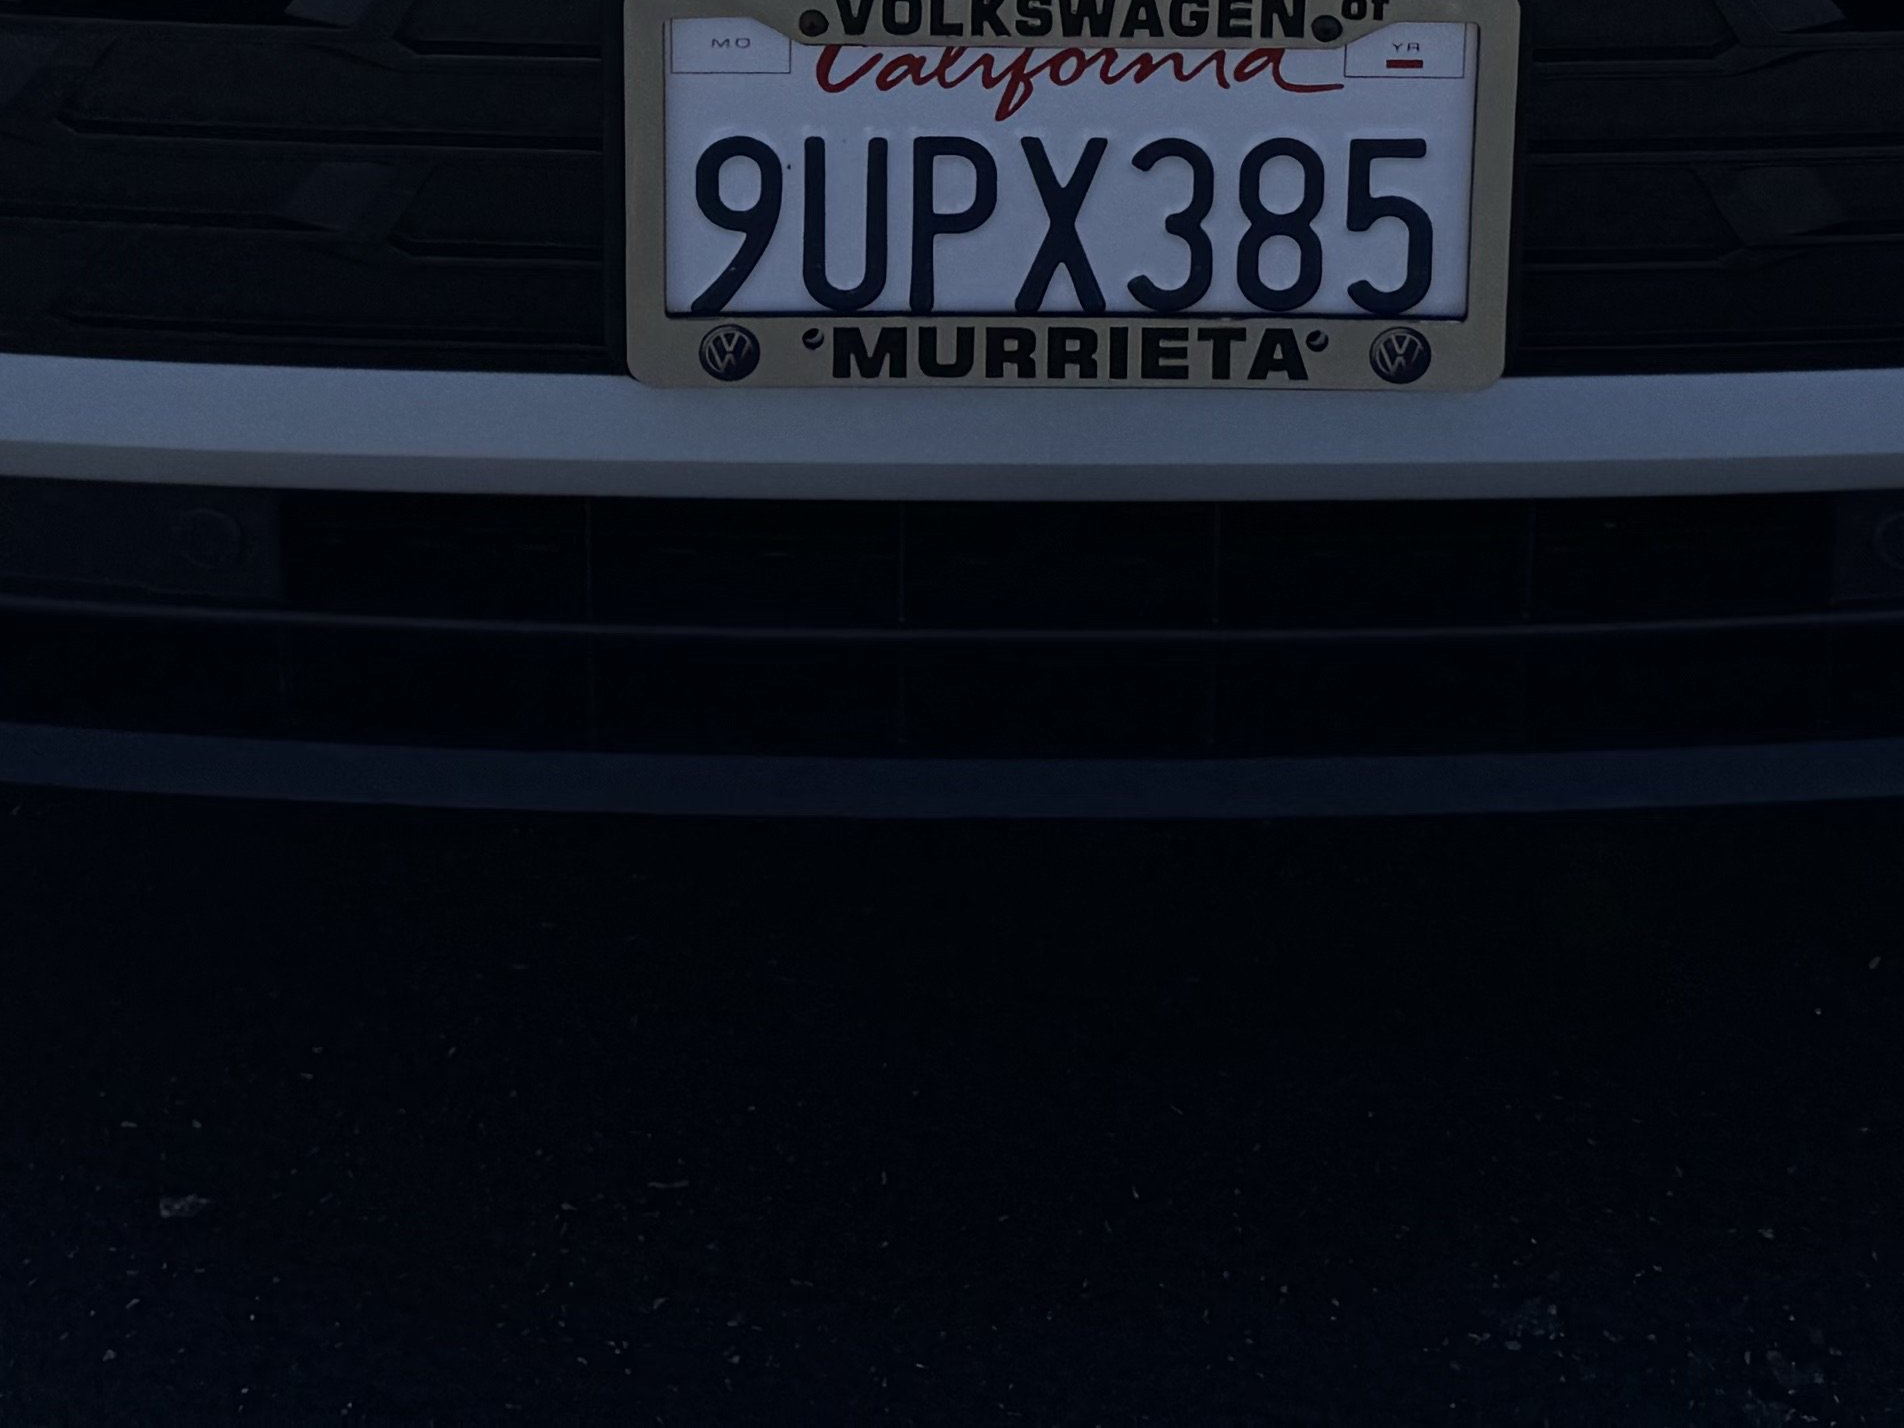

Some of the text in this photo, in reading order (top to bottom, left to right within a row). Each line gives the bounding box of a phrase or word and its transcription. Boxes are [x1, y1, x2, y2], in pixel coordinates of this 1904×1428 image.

[710, 36, 752, 50] MO
[690, 134, 1436, 315] 9UPX385
[831, 325, 1309, 382] MURRIETA
